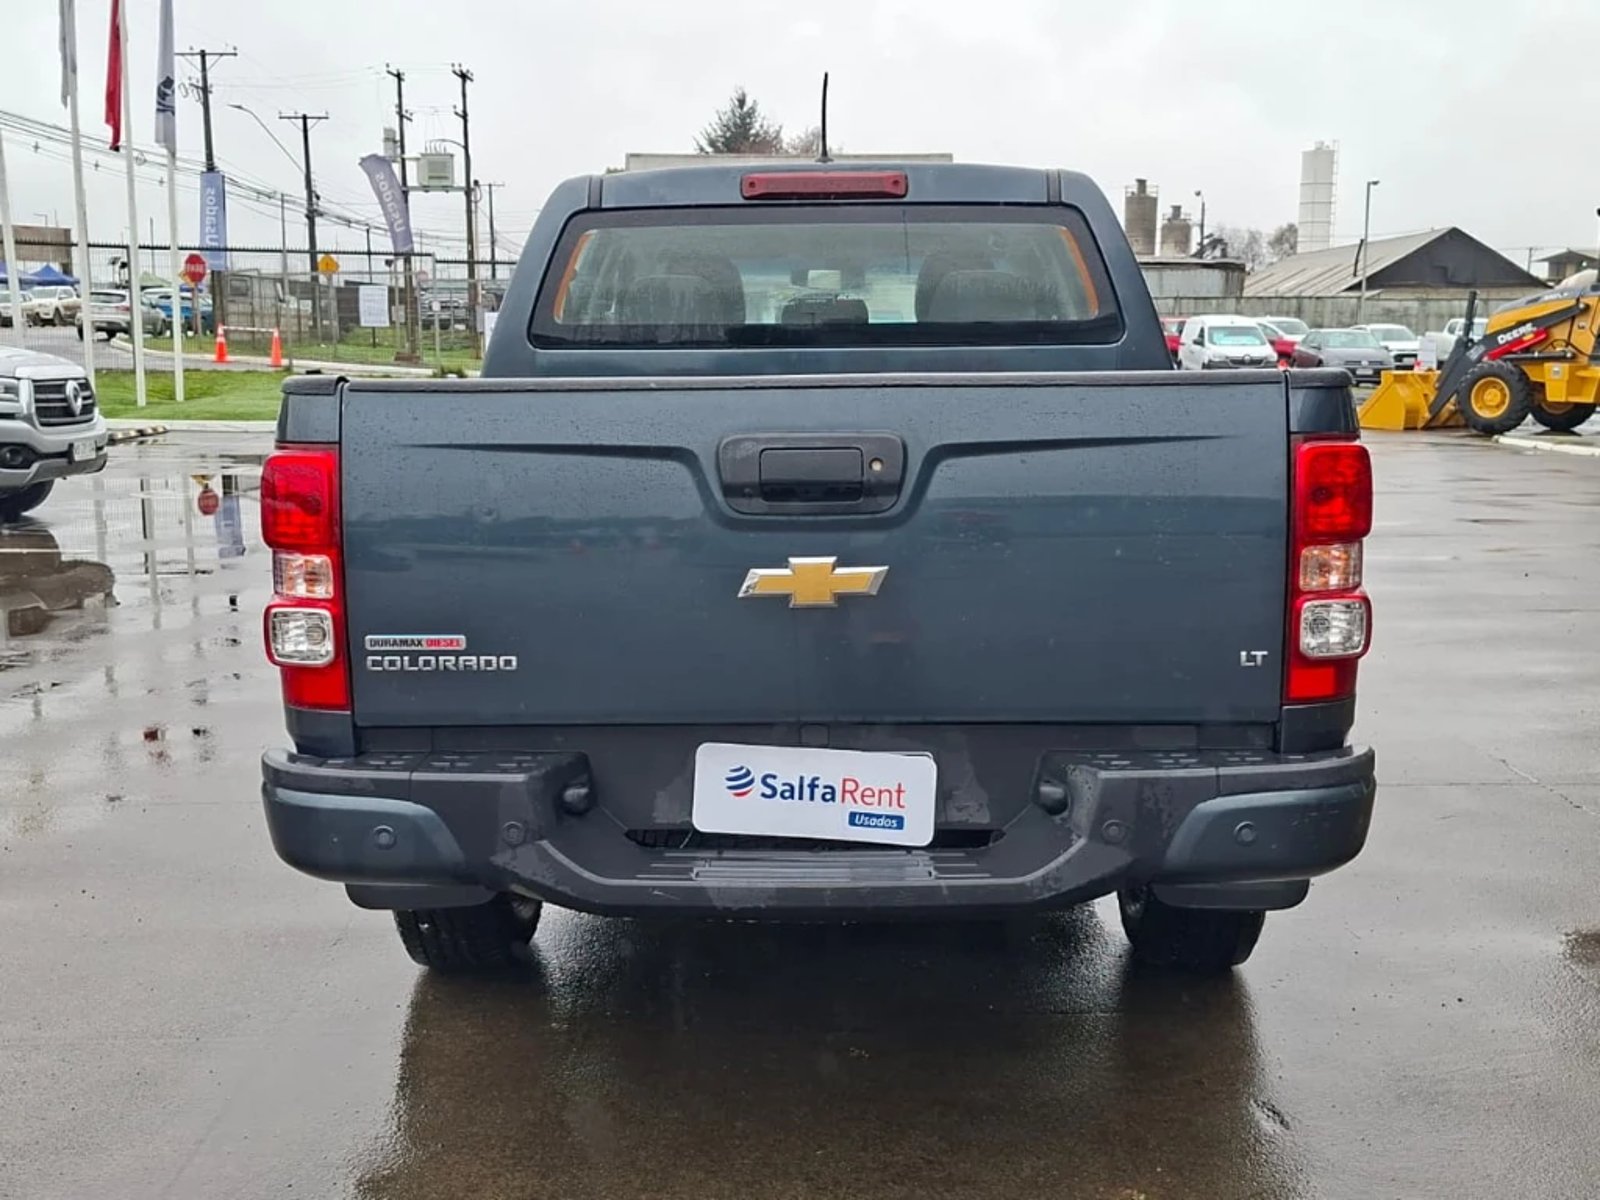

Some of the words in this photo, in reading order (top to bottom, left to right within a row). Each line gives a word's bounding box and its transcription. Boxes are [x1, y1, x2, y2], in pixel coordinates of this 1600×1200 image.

[1497, 322, 1532, 344] DEERE
[369, 637, 424, 648] DURAMAX
[425, 637, 462, 648] DIESEL
[366, 655, 518, 671] COLORADO
[1240, 650, 1268, 667] LT
[760, 773, 906, 809] SalfaRent
[854, 814, 898, 828] Usados
